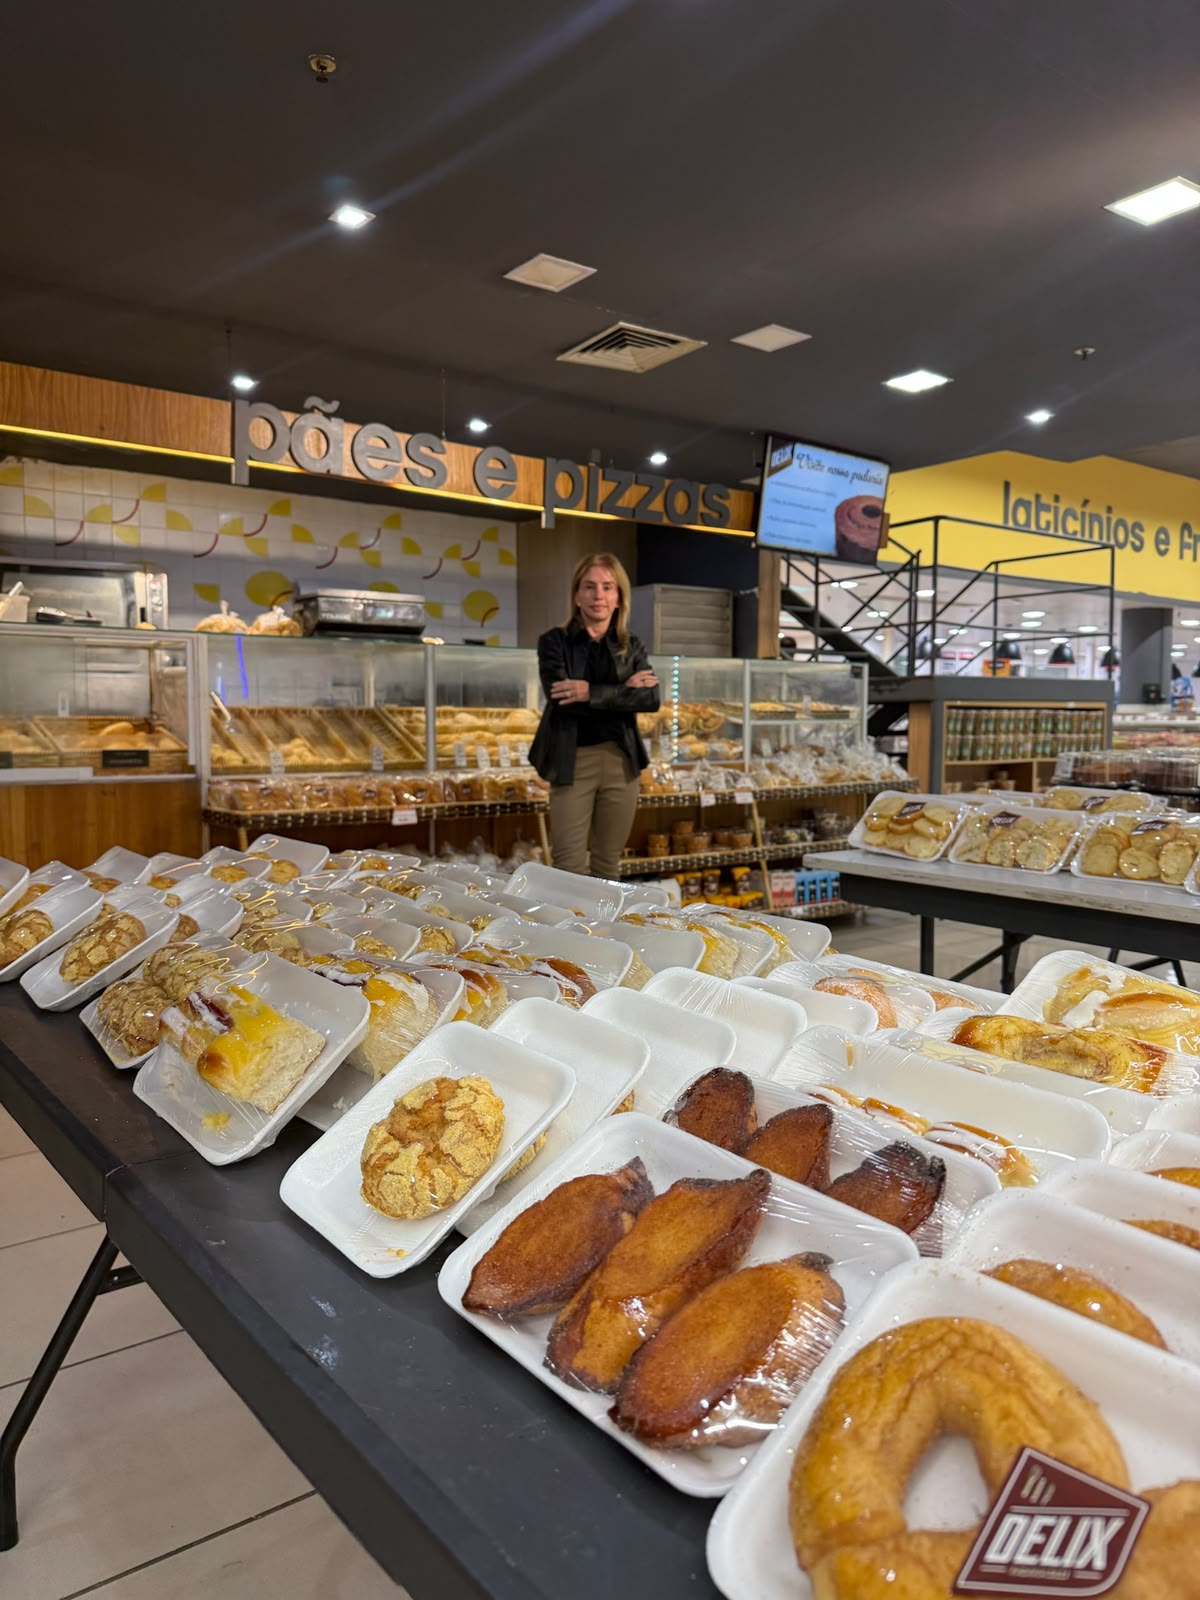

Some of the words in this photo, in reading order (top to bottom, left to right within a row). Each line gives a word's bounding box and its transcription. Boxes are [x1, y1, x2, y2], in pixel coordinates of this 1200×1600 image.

[232, 395, 448, 485] pães
[473, 445, 518, 500] e
[541, 449, 731, 529] pizzas
[1003, 480, 1145, 552] laticínios
[1154, 526, 1170, 556] e
[983, 1513, 1125, 1570] DELIX
